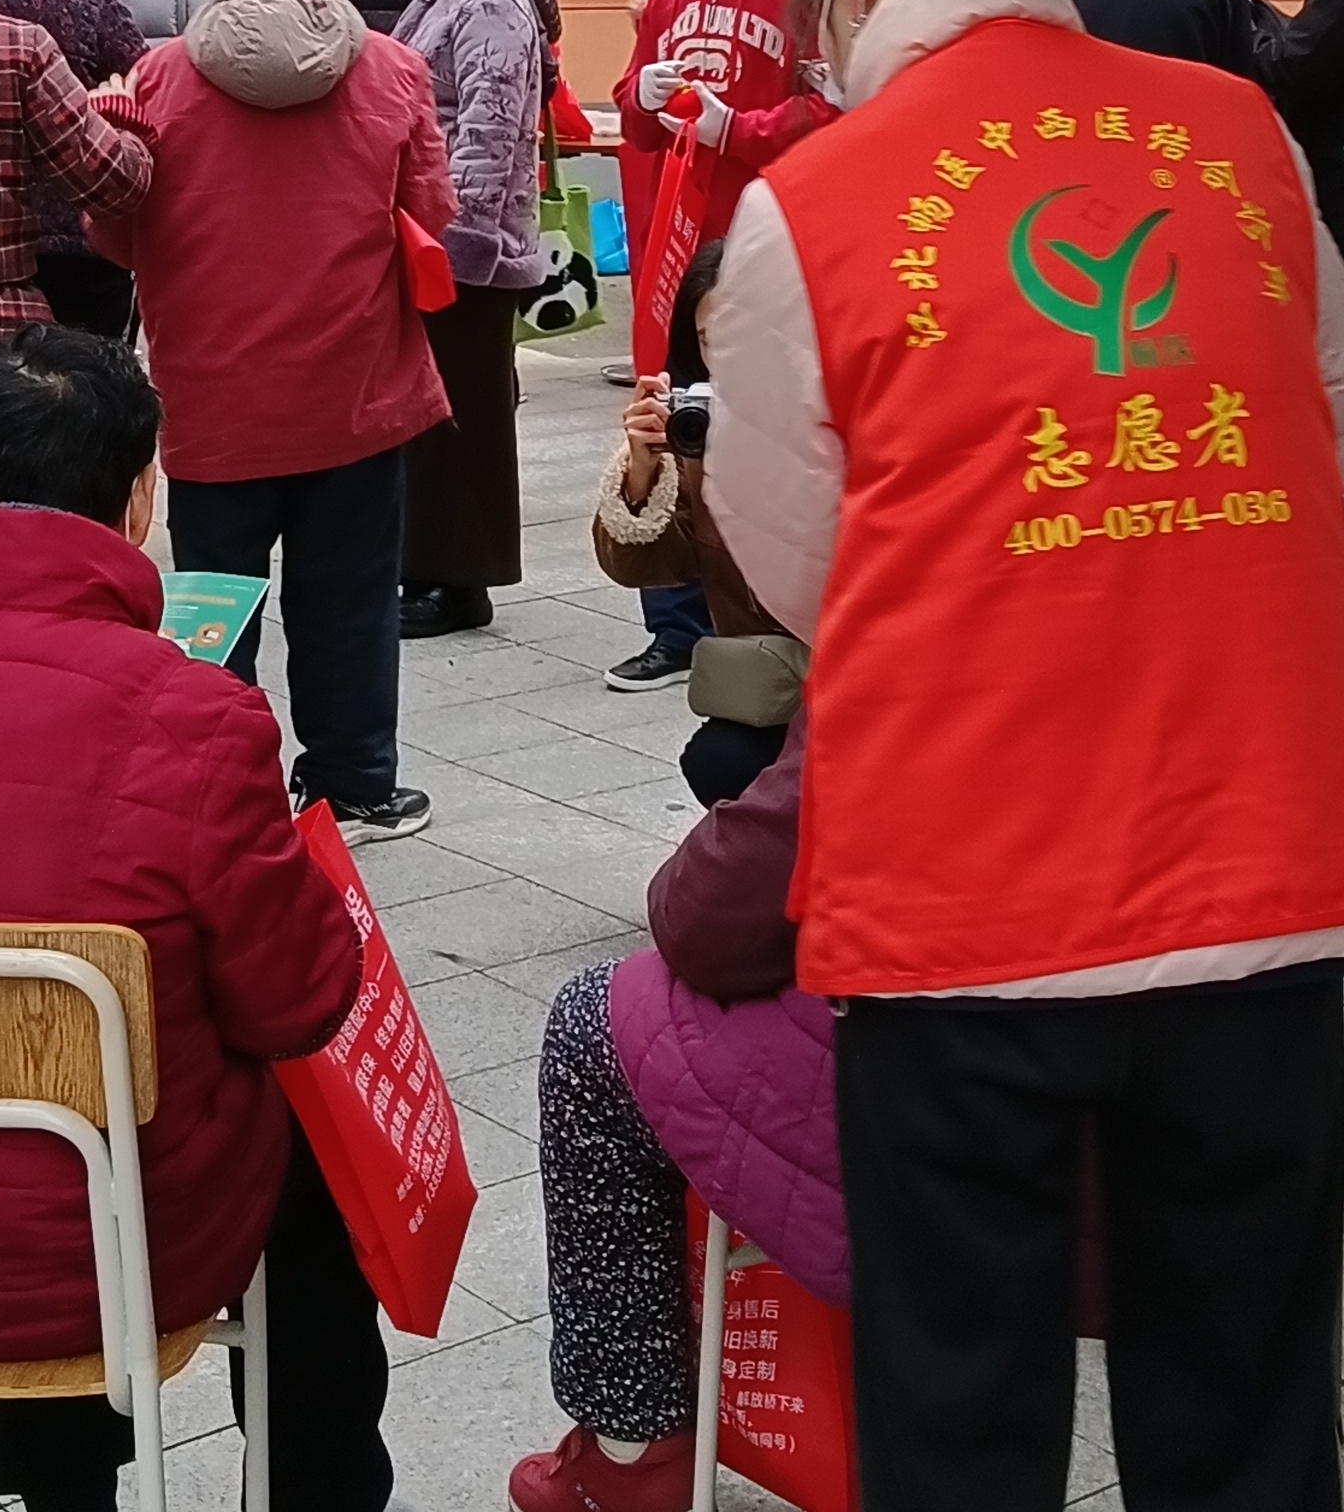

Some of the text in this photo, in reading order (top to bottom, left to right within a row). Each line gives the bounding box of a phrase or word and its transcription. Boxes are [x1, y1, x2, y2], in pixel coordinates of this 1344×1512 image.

[1021, 382, 1251, 493] 志愿者
[1003, 489, 1293, 555] 400-0574-036
